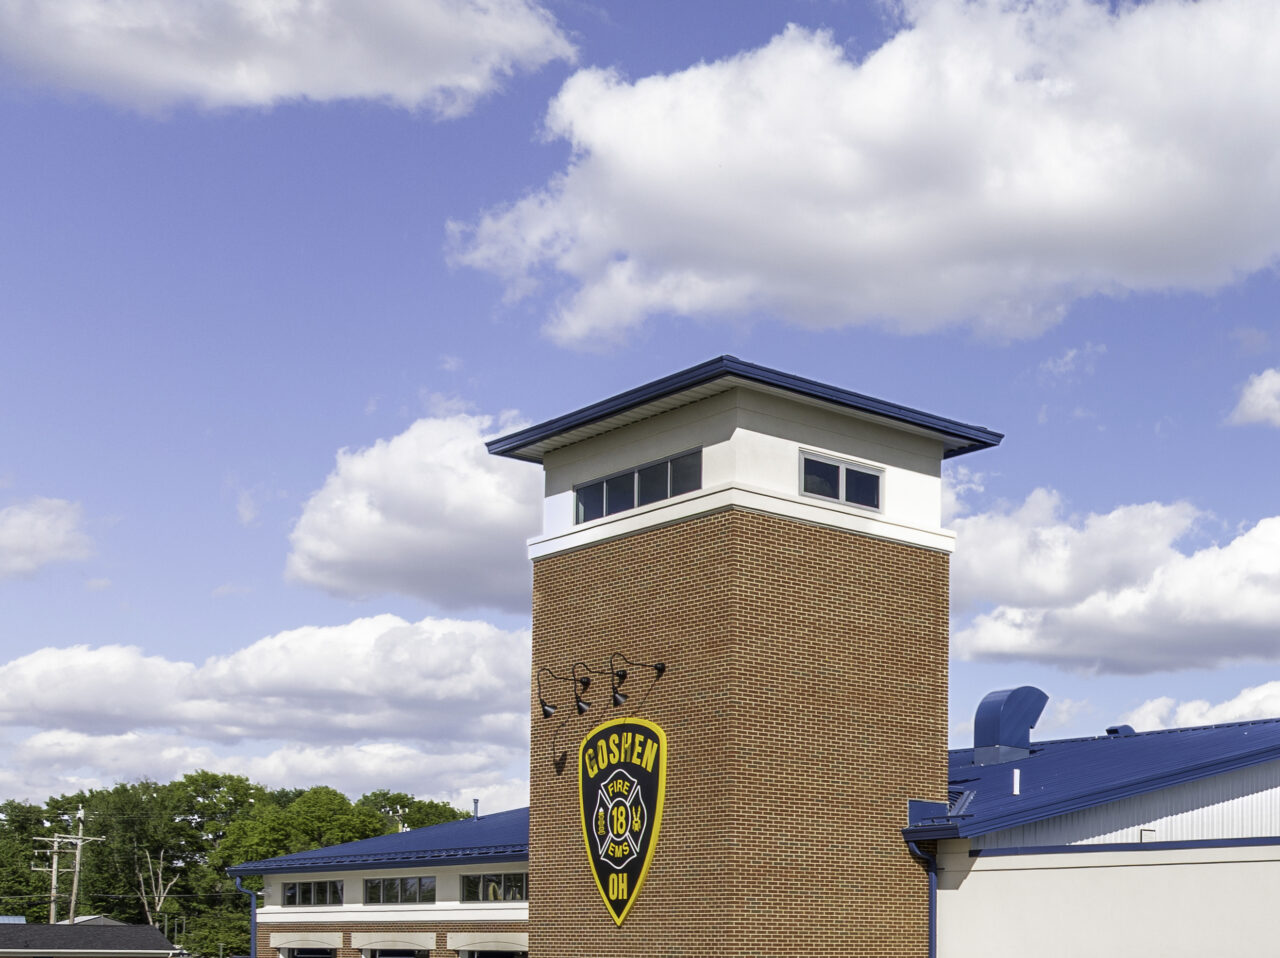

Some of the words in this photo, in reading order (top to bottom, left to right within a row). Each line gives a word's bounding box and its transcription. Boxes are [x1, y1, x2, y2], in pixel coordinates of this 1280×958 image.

[585, 732, 658, 779] GOSHEN
[608, 779, 630, 797] FIRE
[612, 806, 626, 835] 18
[608, 842, 630, 858] EMS
[608, 872, 628, 901] OH
